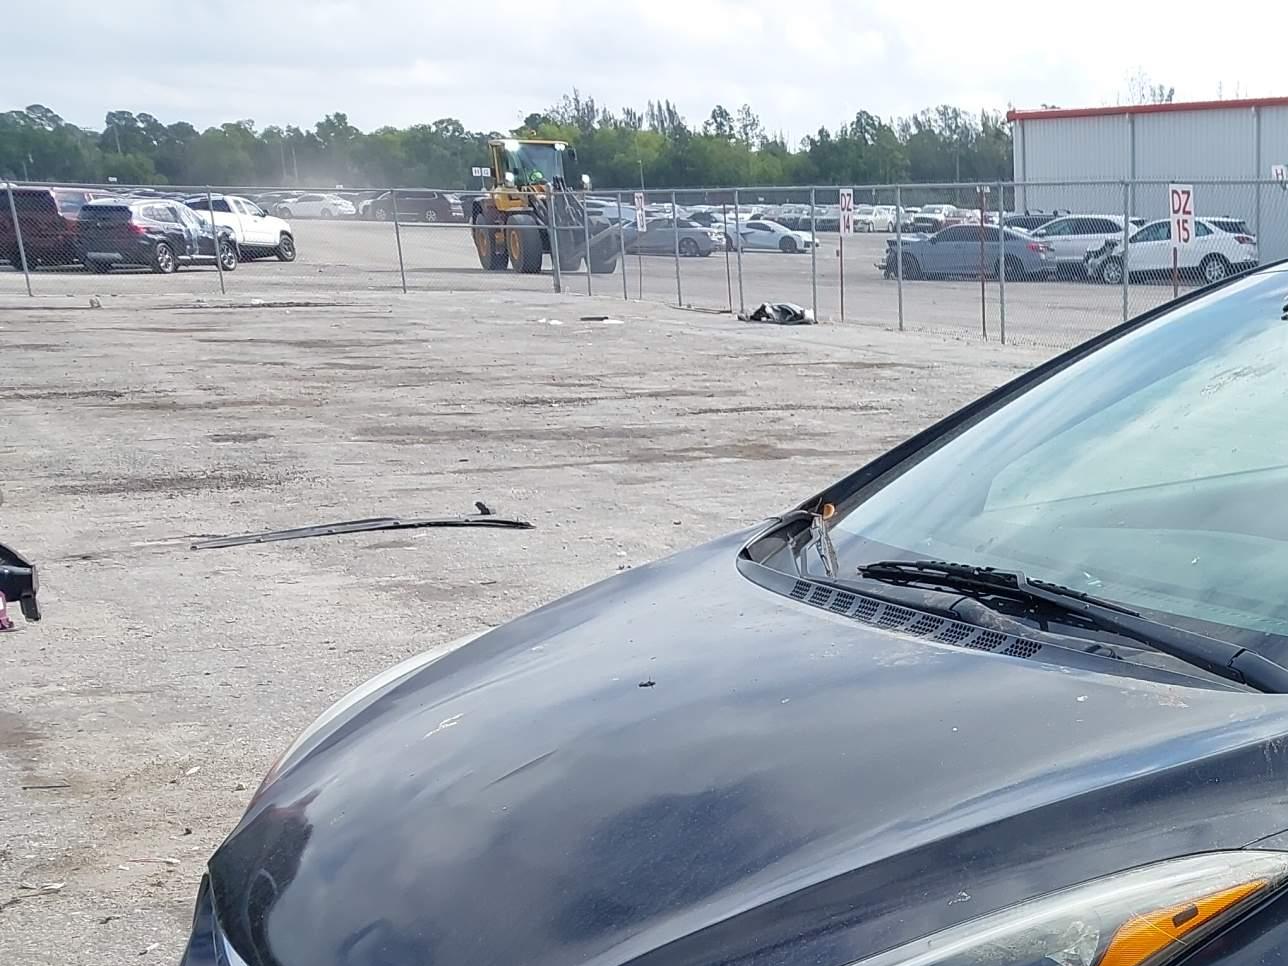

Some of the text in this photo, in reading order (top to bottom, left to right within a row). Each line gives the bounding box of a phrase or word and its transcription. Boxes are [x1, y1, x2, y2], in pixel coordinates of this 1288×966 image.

[840, 193, 852, 212] DZ
[1171, 189, 1192, 215] DZ
[1176, 218, 1190, 243] 15
